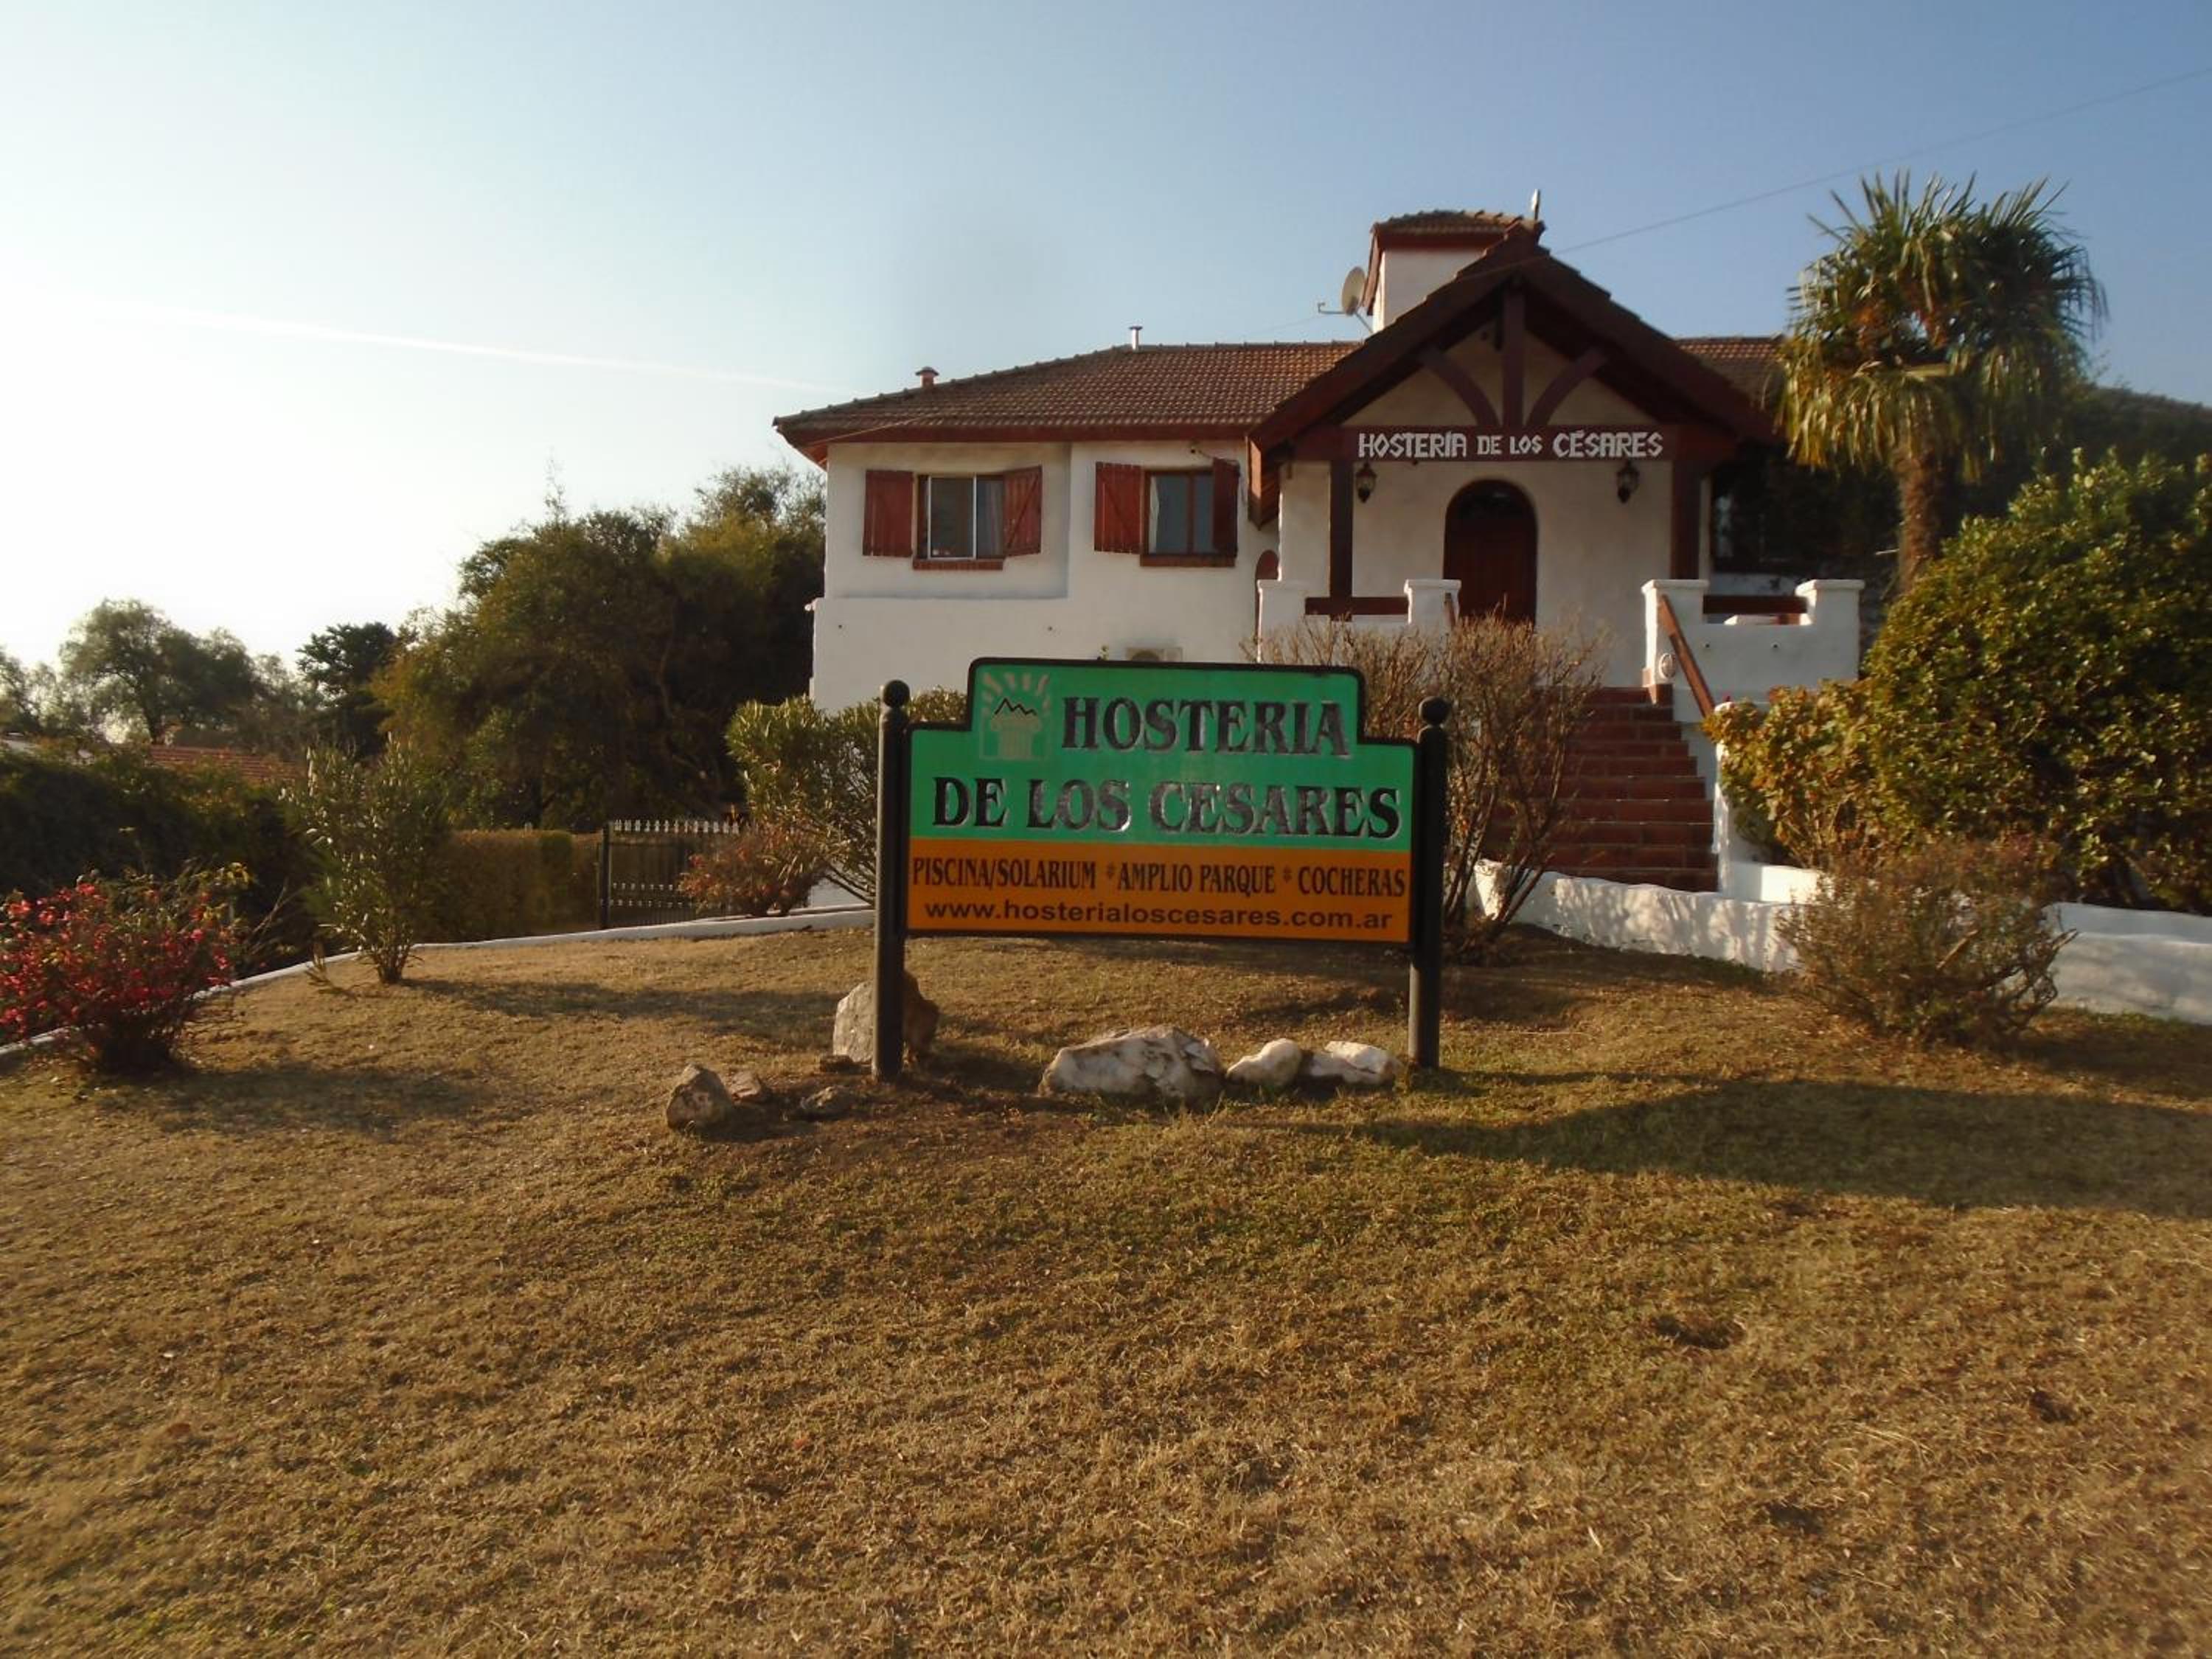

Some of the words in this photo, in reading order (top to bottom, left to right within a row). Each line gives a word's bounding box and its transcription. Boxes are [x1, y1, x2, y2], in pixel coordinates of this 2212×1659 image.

[1477, 435, 1502, 455] DE
[1510, 435, 1543, 454] LOS
[1062, 696, 1352, 757] HOSTERIA
[932, 776, 1009, 829] DE
[1026, 777, 1132, 832] LOS
[1148, 781, 1401, 839] CESARES
[912, 857, 1096, 889] PISCINA/SOLARIUM
[1199, 864, 1276, 897] PARQUE
[1298, 866, 1405, 897] COCHERAS
[924, 899, 1393, 929] www.hosterialoscesares.com.ar
